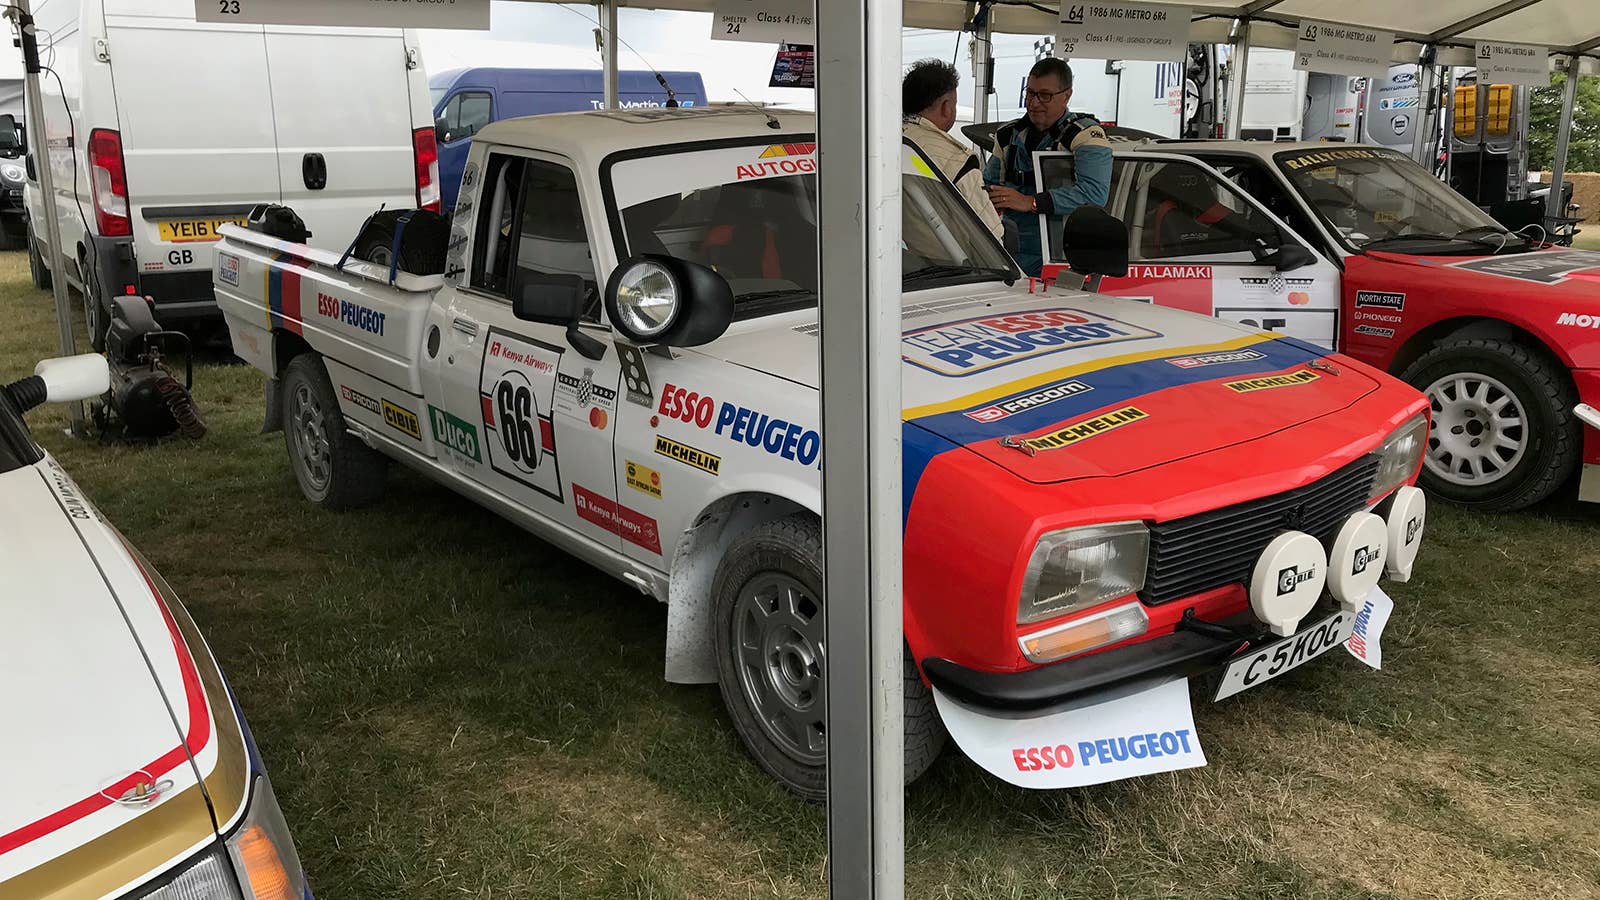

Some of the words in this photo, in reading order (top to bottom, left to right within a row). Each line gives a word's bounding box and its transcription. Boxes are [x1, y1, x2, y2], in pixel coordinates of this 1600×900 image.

[219, 0, 241, 14] 23
[1068, 5, 1084, 21] 64
[1089, 7, 1108, 18] 1986
[1110, 9, 1123, 19] MG
[1125, 9, 1151, 21] METRO
[1153, 11, 1167, 21] 6R4
[722, 15, 747, 24] SHELTER
[757, 12, 781, 24] Class
[726, 23, 741, 34] 24
[1305, 25, 1318, 39] 63
[1320, 27, 1334, 38] 1986
[1334, 29, 1345, 38] MG
[1346, 31, 1365, 41] METRO
[1085, 33, 1103, 42] Class
[1064, 43, 1075, 53] 25
[1481, 45, 1491, 57] 62
[1301, 57, 1309, 66] 26
[169, 222, 208, 237] YE16
[168, 249, 194, 265] GB
[1143, 266, 1211, 278] ALAMAKI
[1359, 293, 1381, 303] NORTH
[1382, 295, 1402, 305] STATE
[318, 292, 339, 320] ESSO
[341, 300, 386, 336] PEUGEOT
[1362, 313, 1402, 323] PIONEER
[903, 321, 999, 351] TEAM
[980, 311, 1090, 334] ESSO
[929, 322, 1131, 369] PEUGEOT
[502, 347, 522, 363] Kenya
[524, 355, 553, 374] Airways
[1197, 350, 1258, 365] FACOM
[1229, 370, 1316, 392] MICHELIN
[352, 392, 380, 415] FACOM
[1002, 381, 1085, 413] FACOM
[385, 406, 418, 435] CIBIE
[497, 379, 537, 470] 66
[658, 382, 715, 429] ESSO
[715, 401, 821, 471] PEUGEO
[1028, 407, 1145, 450] MICHELIN
[656, 438, 719, 473] MICHELIN
[588, 500, 610, 519] Kenya
[611, 512, 641, 534] Airways
[1285, 567, 1315, 586] CIBIE
[1012, 744, 1075, 772] ESSO
[1078, 729, 1192, 767] PEUGEOT
